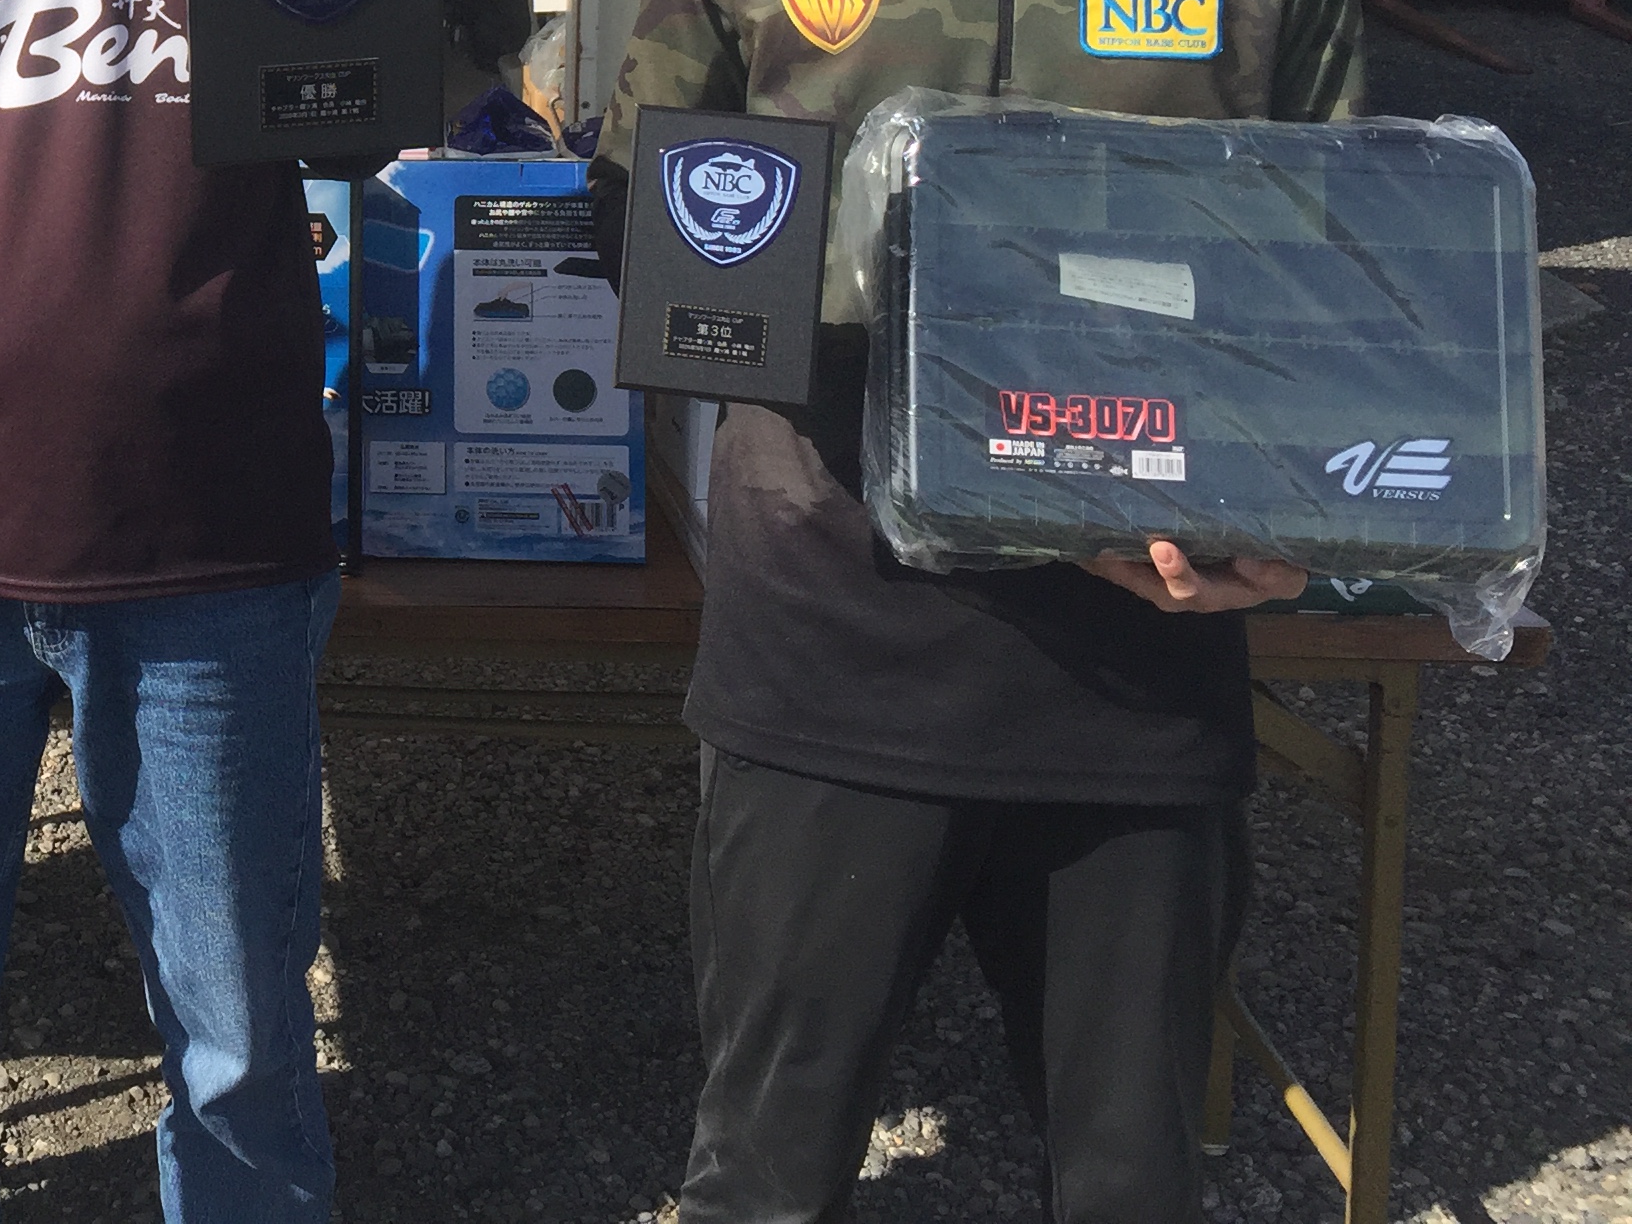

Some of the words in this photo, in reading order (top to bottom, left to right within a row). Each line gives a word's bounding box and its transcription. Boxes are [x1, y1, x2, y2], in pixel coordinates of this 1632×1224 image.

[1098, 36, 1141, 46] NIPPON
[1145, 37, 1174, 48] BASS
[1177, 39, 1207, 49] CLUB
[76, 89, 132, 103] Marina
[300, 83, 338, 101] 優勝
[702, 170, 752, 194] NBC
[696, 322, 733, 338] 第3位
[999, 390, 1176, 443] VS-3070
[1013, 440, 1035, 449] MADE
[1035, 441, 1046, 449] IN
[1013, 446, 1046, 458] JAPAN
[1372, 487, 1442, 502] VERSUS
